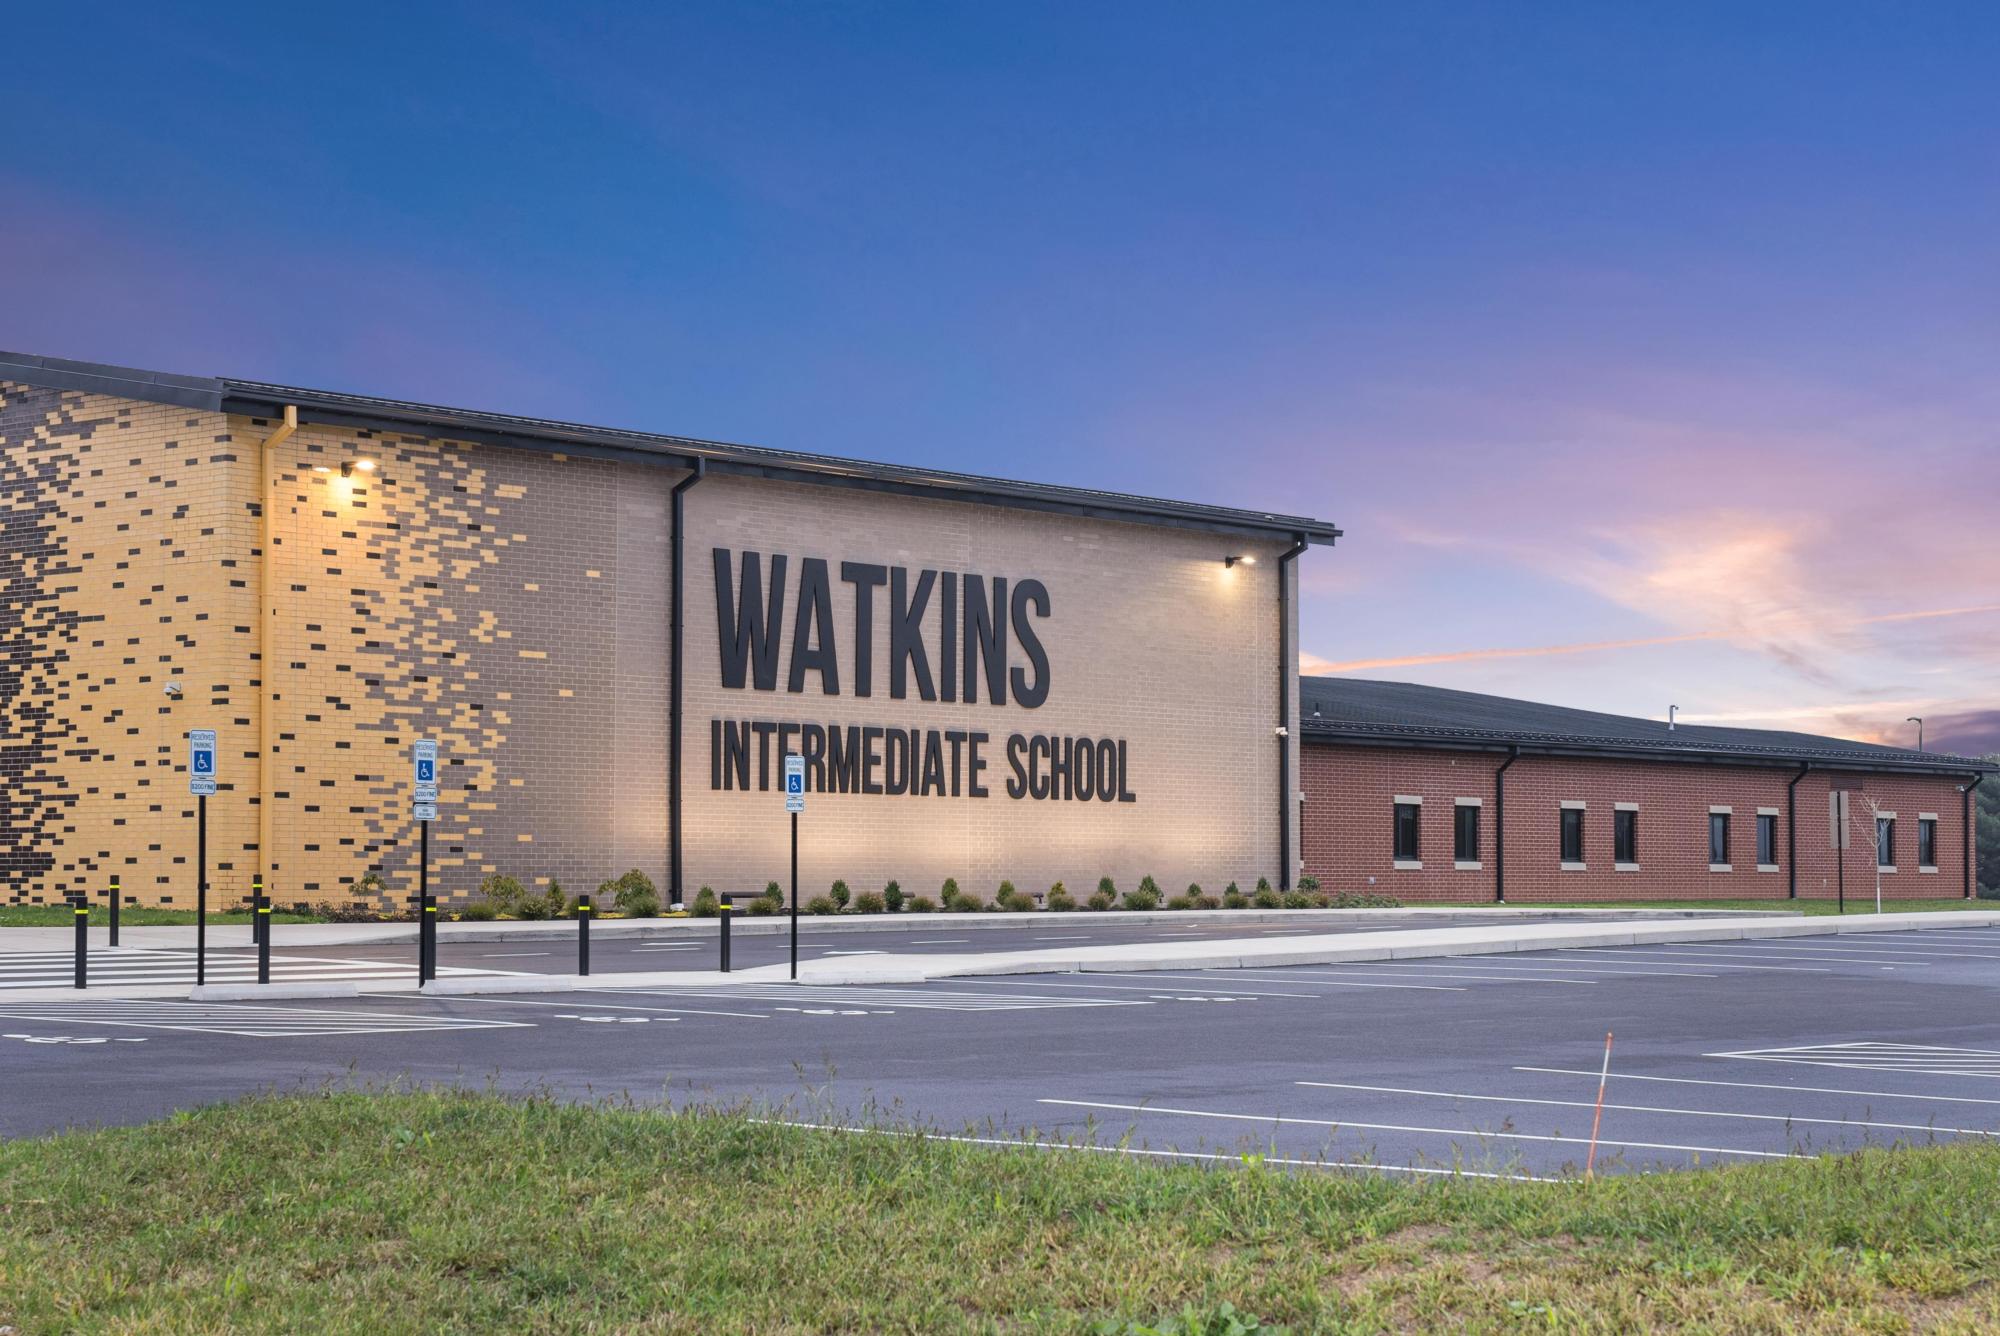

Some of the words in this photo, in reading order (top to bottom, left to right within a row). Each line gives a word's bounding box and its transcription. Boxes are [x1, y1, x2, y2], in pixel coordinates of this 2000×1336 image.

[712, 547, 1051, 708] WATKINS
[711, 719, 989, 798] INTERMEDIATE
[1006, 733, 1136, 802] SCHOOL
